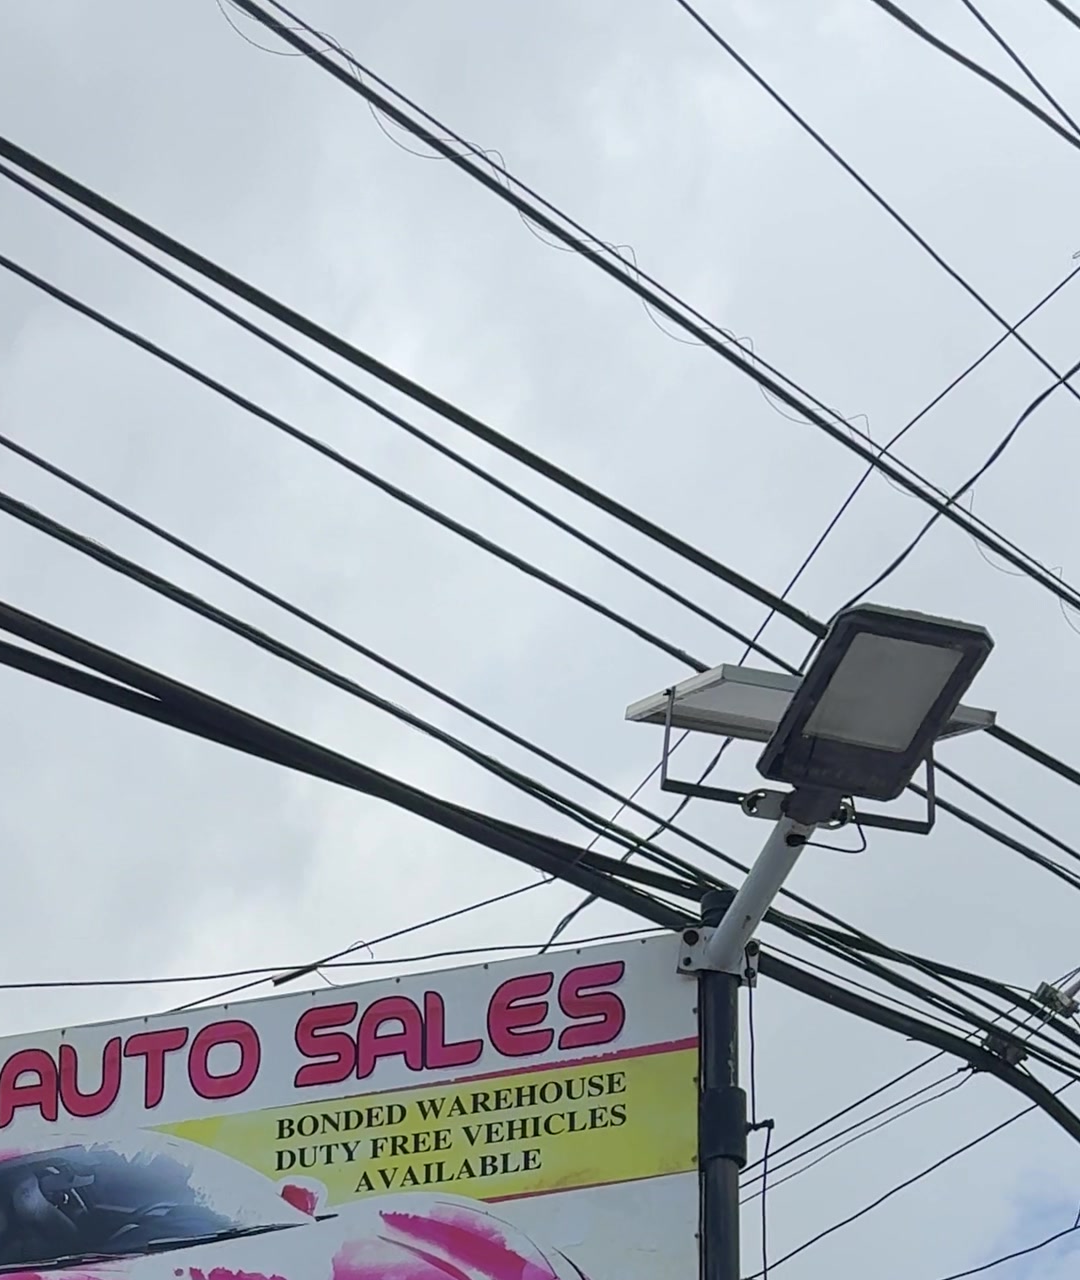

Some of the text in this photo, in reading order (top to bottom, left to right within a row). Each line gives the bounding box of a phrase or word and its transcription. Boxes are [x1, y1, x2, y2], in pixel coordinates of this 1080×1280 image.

[293, 960, 626, 1088] SALES
[274, 1103, 628, 1172] DUTY FREE VEHICLES
[275, 1071, 627, 1141] BONDED WAREHOUSE
[353, 1148, 543, 1193] AVAILABLE
